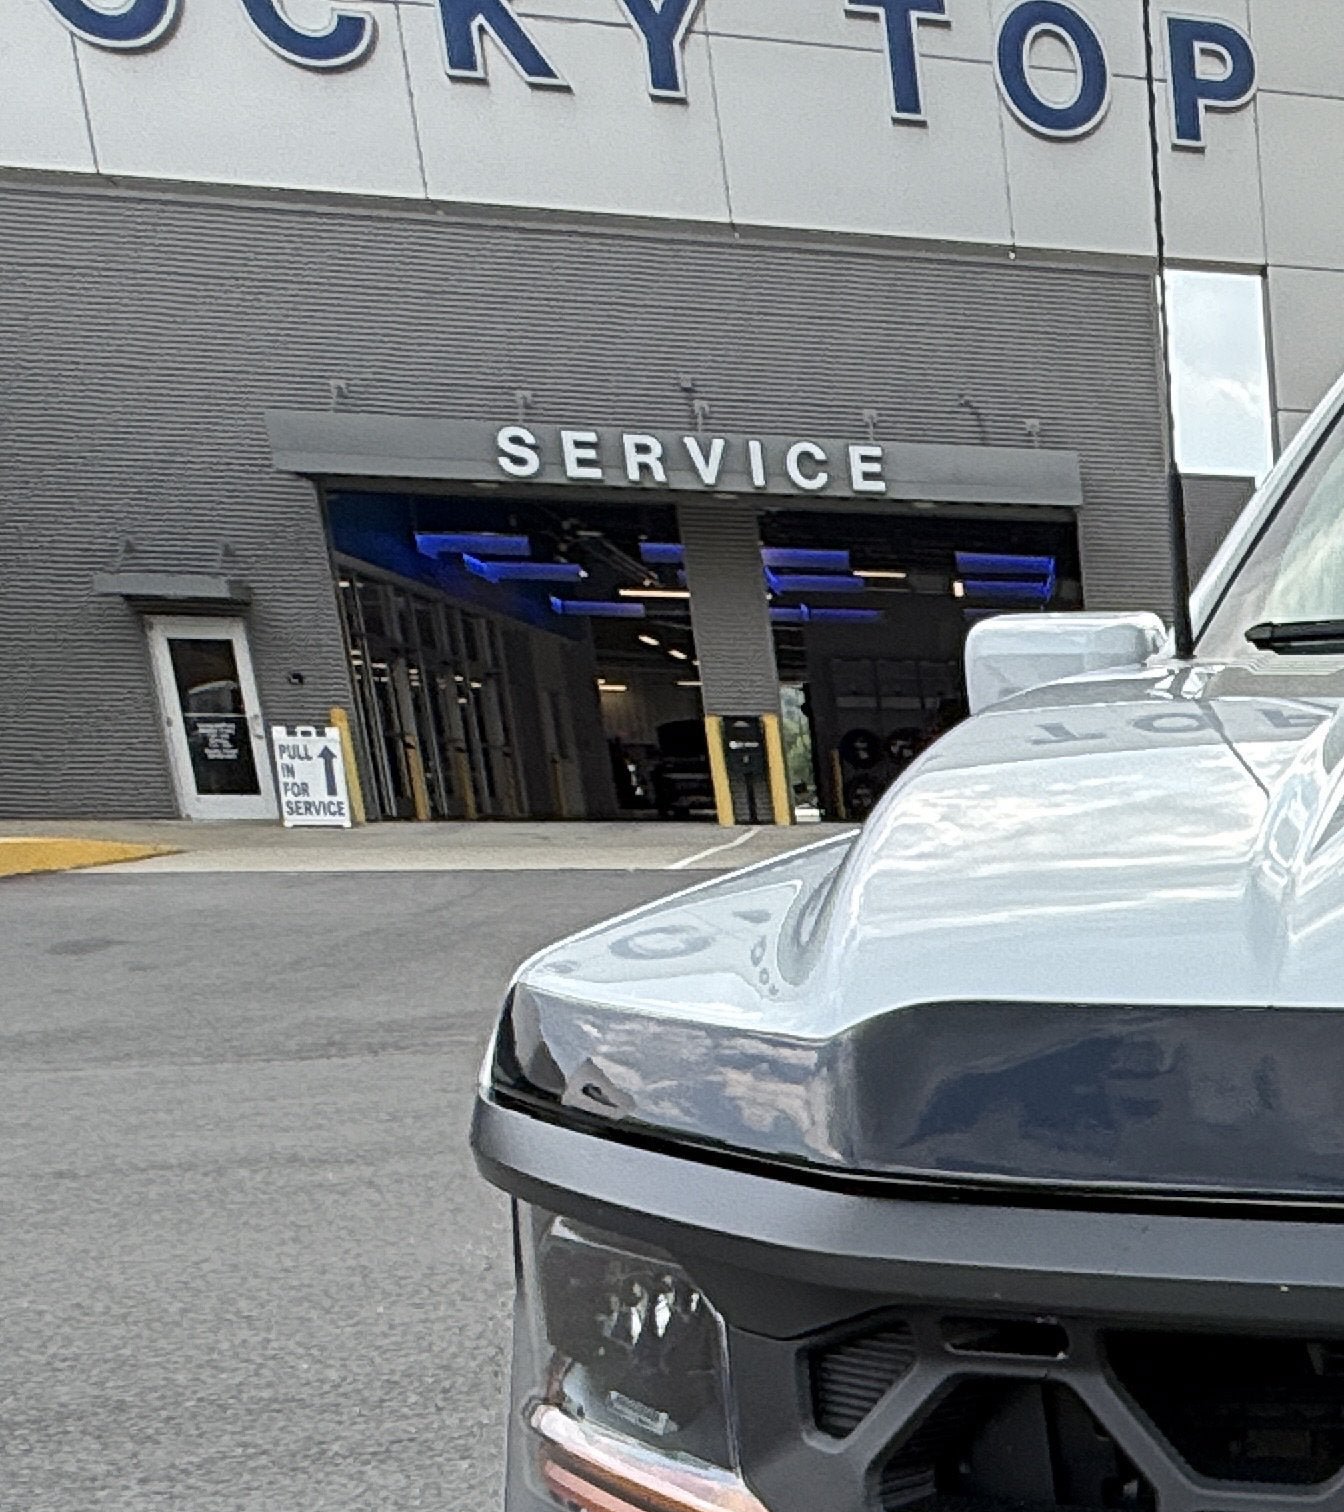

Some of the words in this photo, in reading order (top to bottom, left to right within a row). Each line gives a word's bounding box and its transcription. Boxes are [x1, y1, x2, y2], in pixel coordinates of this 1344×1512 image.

[844, 0, 1257, 148] TOP
[498, 425, 887, 492] SERVICE
[278, 743, 313, 761] PULL
[281, 762, 296, 779] IN
[283, 782, 310, 798] FOR
[286, 800, 346, 817] SERVICE
